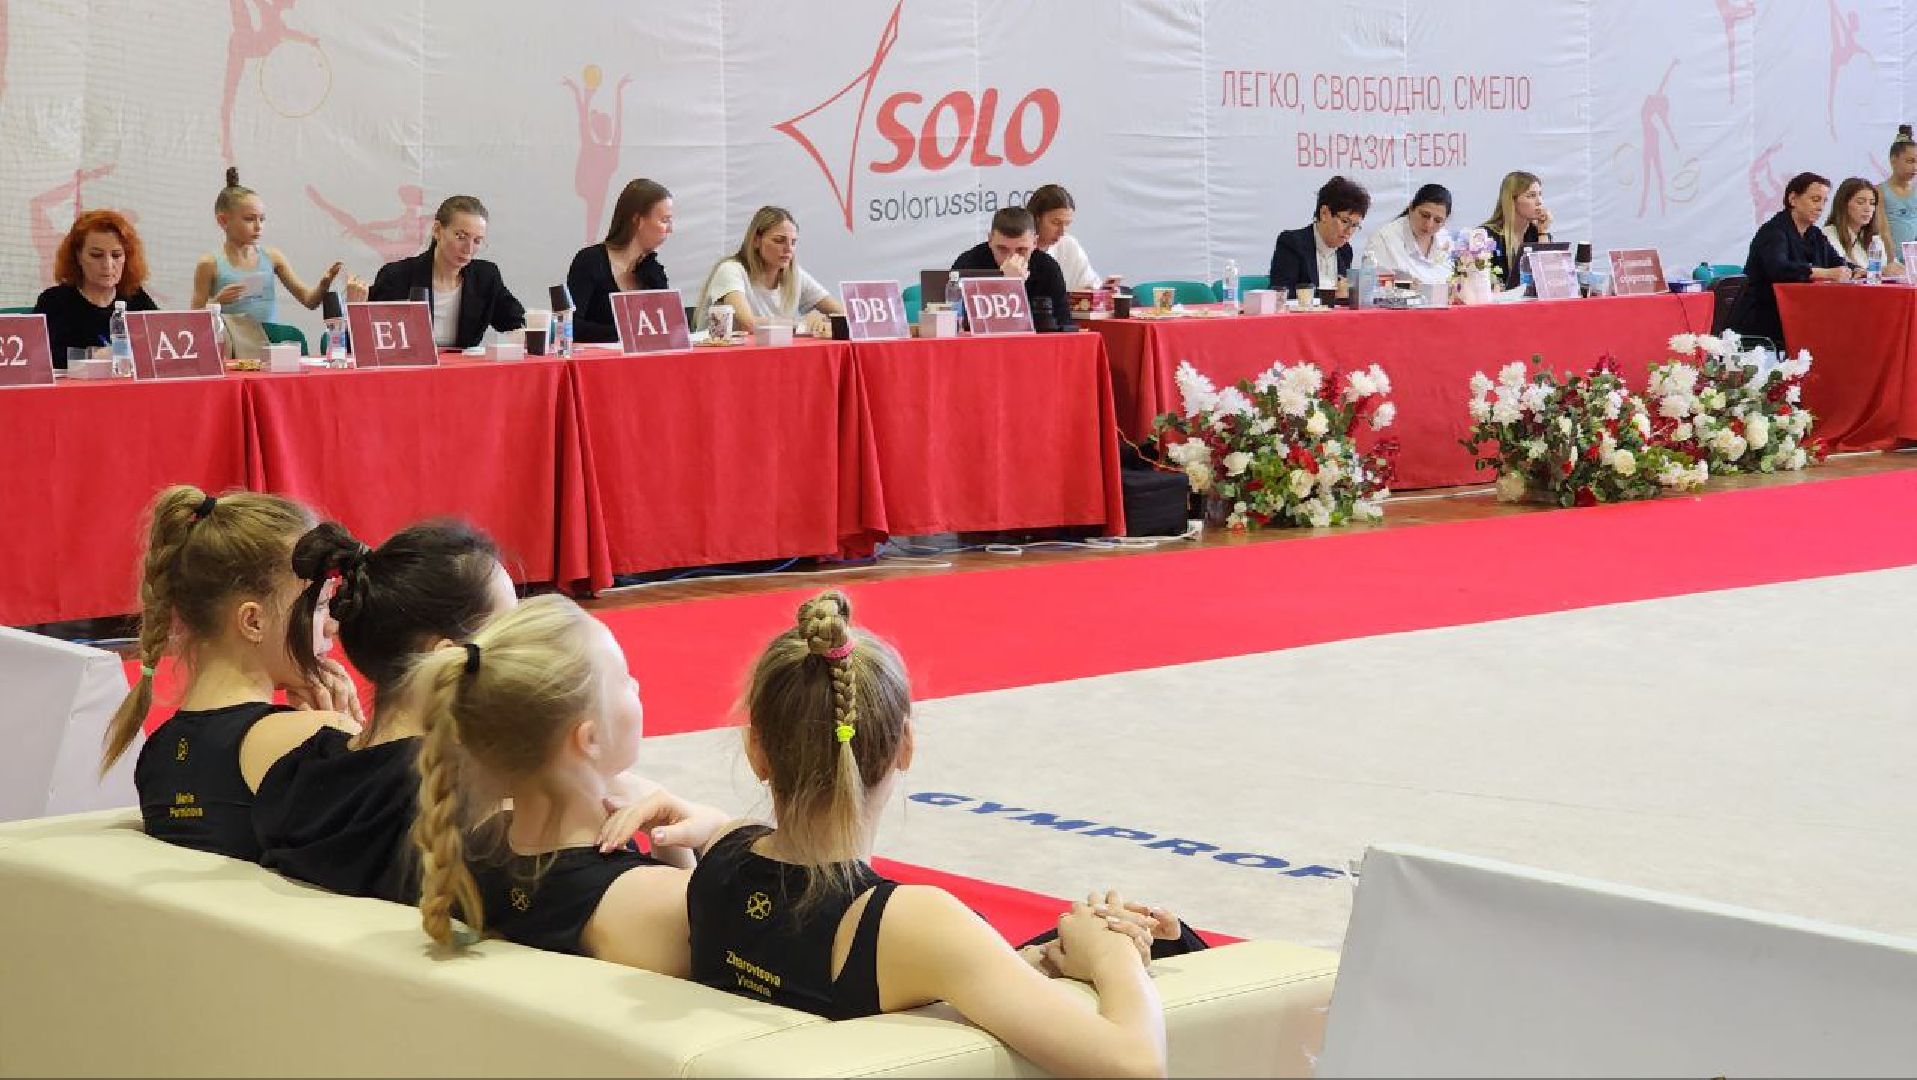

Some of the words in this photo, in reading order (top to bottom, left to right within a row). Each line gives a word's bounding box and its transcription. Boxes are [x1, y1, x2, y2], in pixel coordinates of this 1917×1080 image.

[1221, 70, 1305, 114] ЛЕГКО,
[1313, 74, 1446, 115] СВОБОДНО,
[1454, 75, 1530, 111] СМЕЛО
[870, 88, 1060, 173] SOLO
[1296, 132, 1395, 169] ВЫРАЗИ
[1403, 132, 1467, 167] СЕБЯ!
[637, 307, 671, 336] A1
[849, 297, 899, 323] DB1
[972, 294, 1025, 320] DB2
[155, 330, 198, 360] A2
[373, 320, 412, 350] E1
